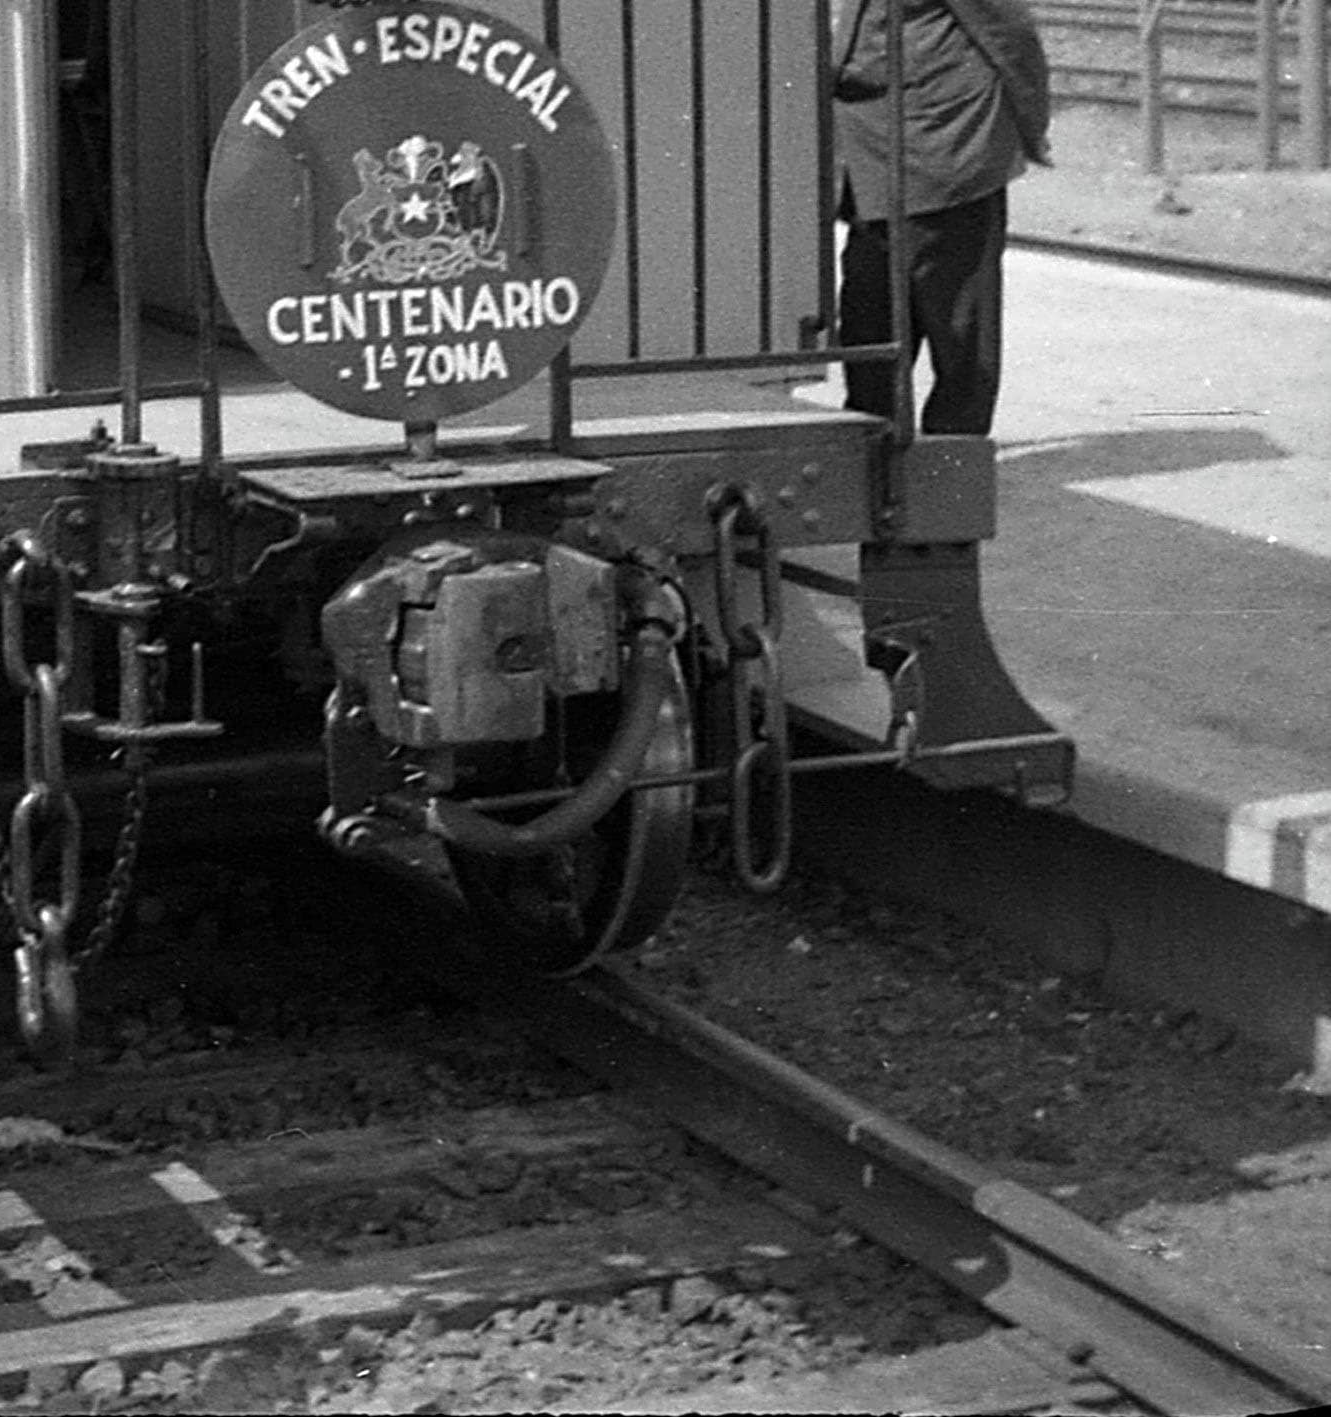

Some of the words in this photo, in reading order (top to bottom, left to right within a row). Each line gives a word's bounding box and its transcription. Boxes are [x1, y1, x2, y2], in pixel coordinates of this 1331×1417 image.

[242, 33, 351, 138] TREN
[376, 14, 570, 132] ESPECIAL
[268, 277, 579, 344] CENTENARIO
[405, 340, 509, 387] ZONA
